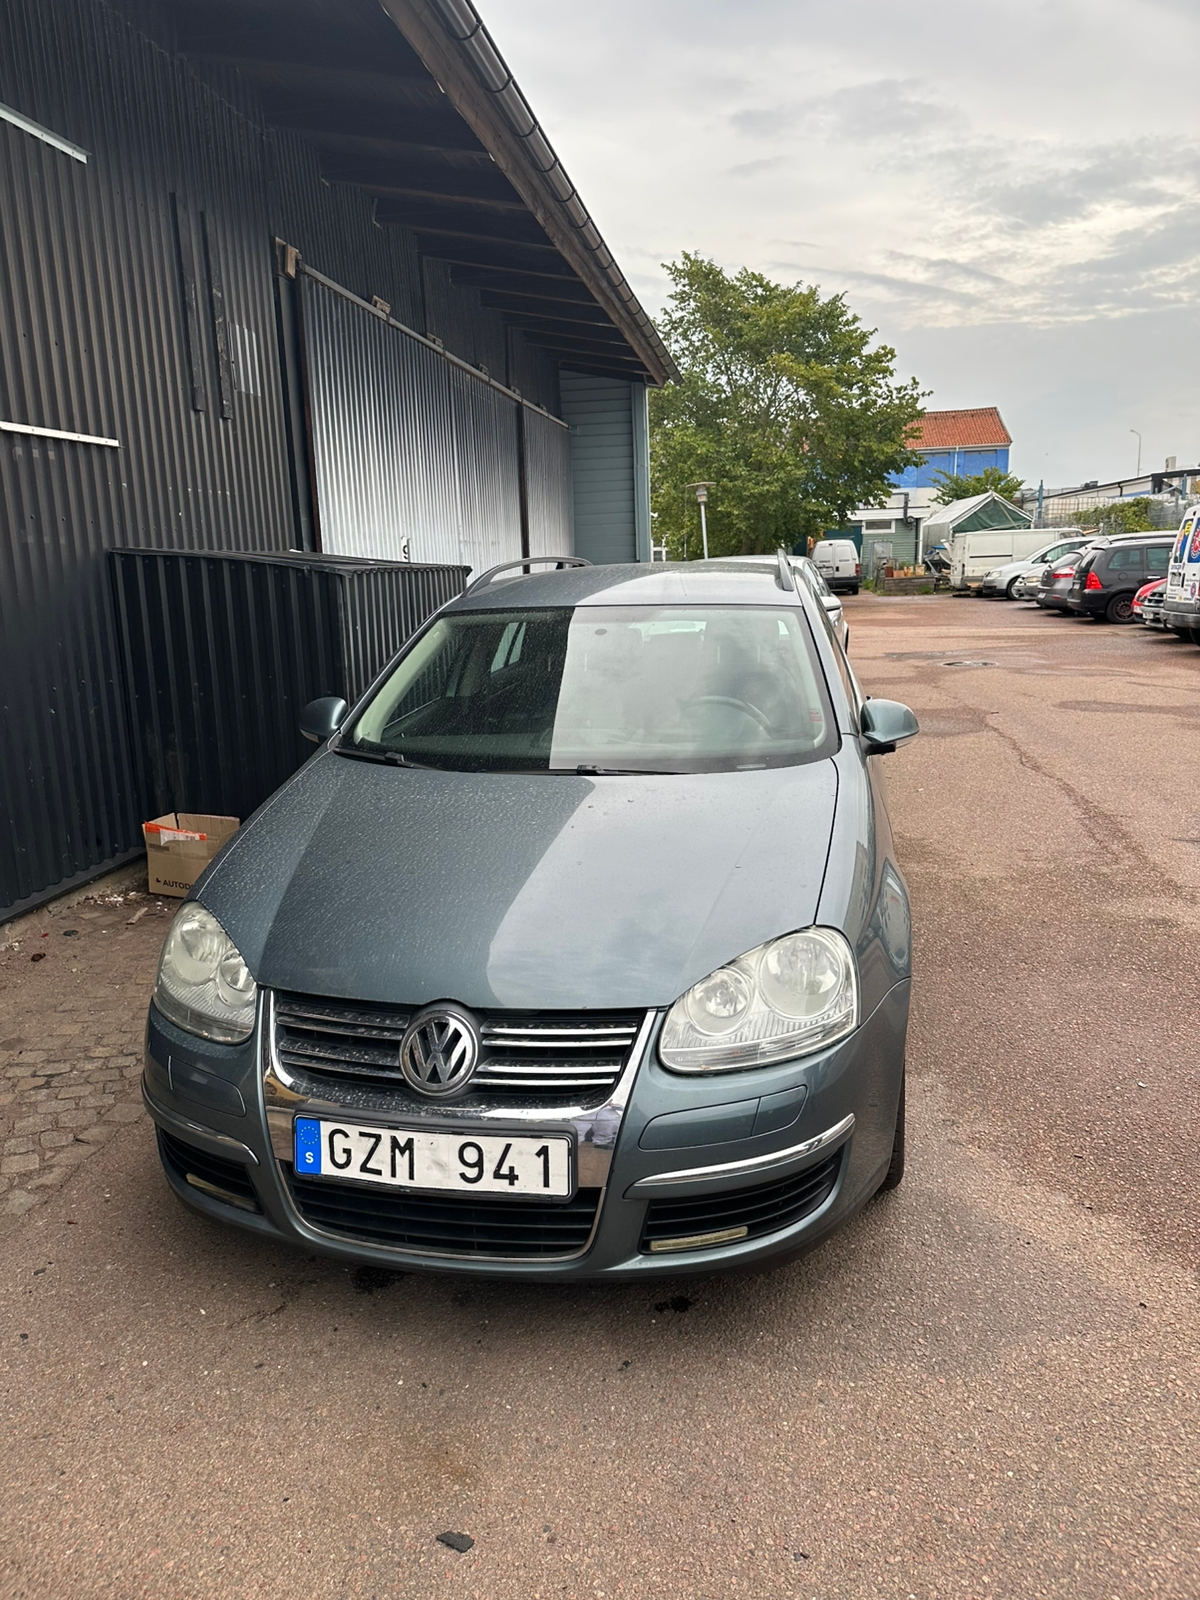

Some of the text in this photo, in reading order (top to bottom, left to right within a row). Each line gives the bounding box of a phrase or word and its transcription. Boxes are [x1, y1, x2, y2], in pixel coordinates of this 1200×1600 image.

[163, 880, 193, 890] AUTOD
[305, 1152, 314, 1164] S
[328, 1128, 551, 1188] GZM 941
